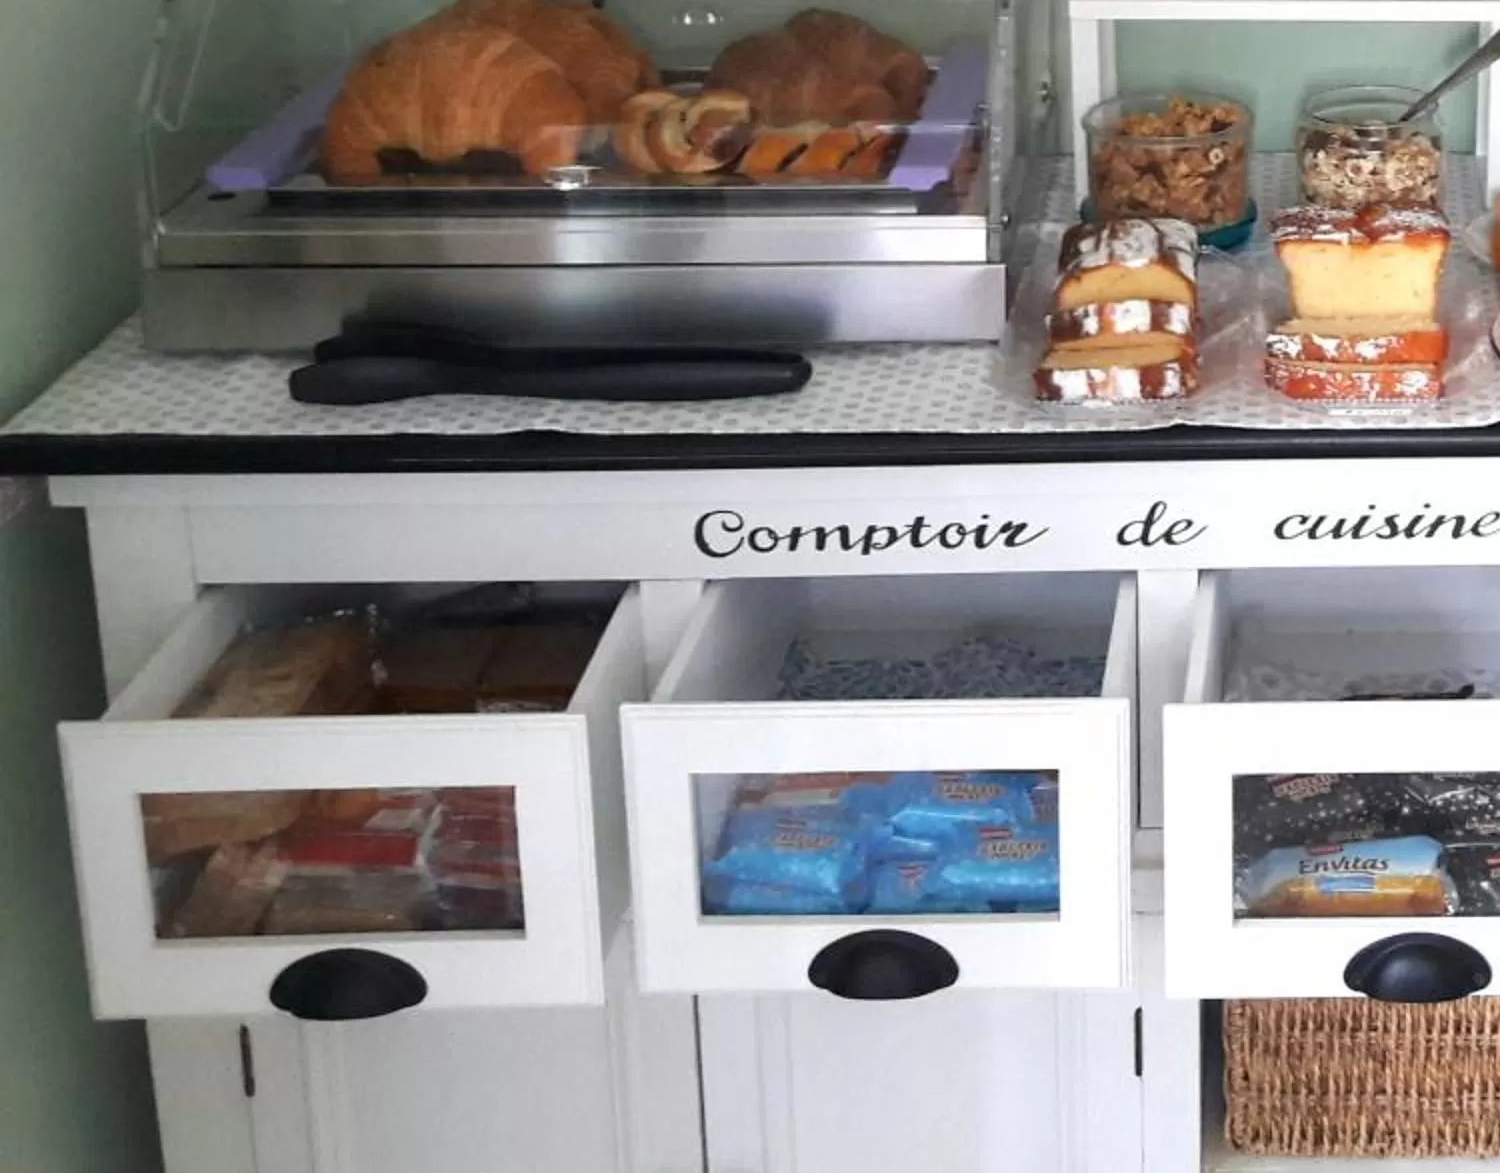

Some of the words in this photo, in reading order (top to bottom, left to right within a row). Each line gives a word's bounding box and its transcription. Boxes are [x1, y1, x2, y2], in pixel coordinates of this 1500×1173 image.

[694, 509, 1051, 558] Comptoir
[1115, 500, 1208, 547] de
[1298, 854, 1390, 876] Envitas
